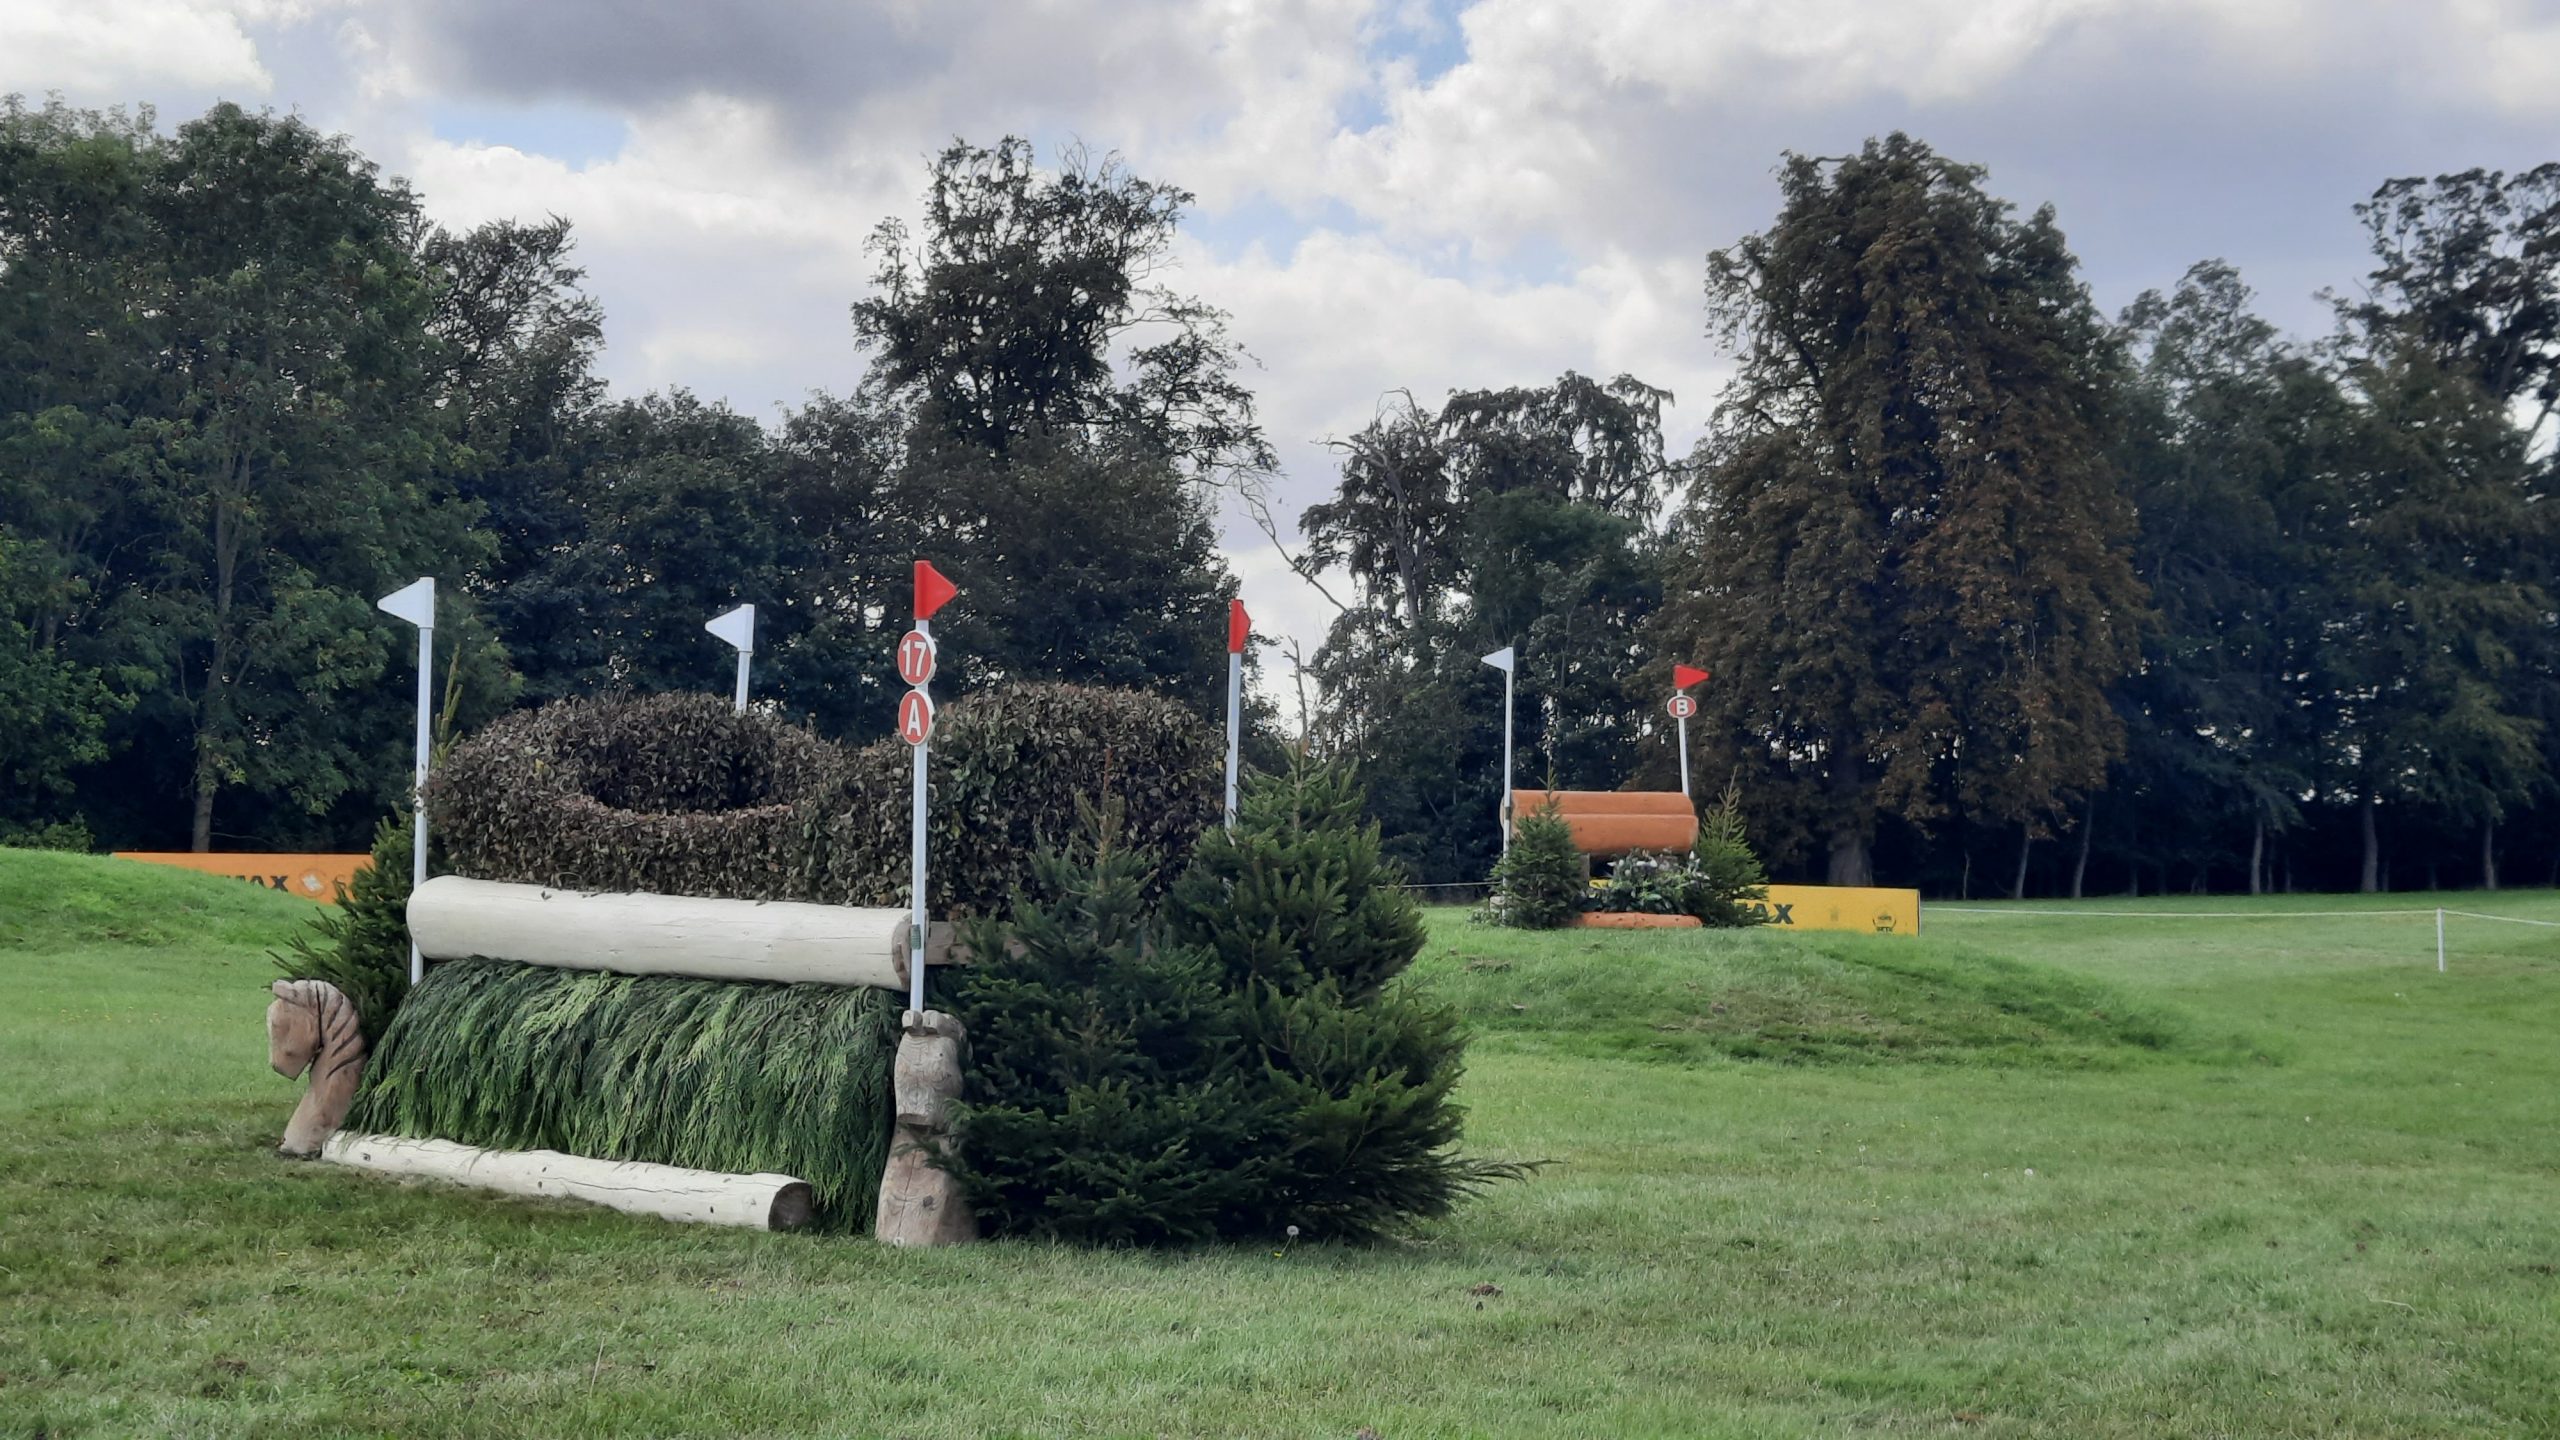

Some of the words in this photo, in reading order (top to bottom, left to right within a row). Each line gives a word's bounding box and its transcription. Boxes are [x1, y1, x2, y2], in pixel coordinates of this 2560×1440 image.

[902, 639, 927, 677] 17
[906, 698, 922, 737] A
[1676, 699, 1689, 715] B
